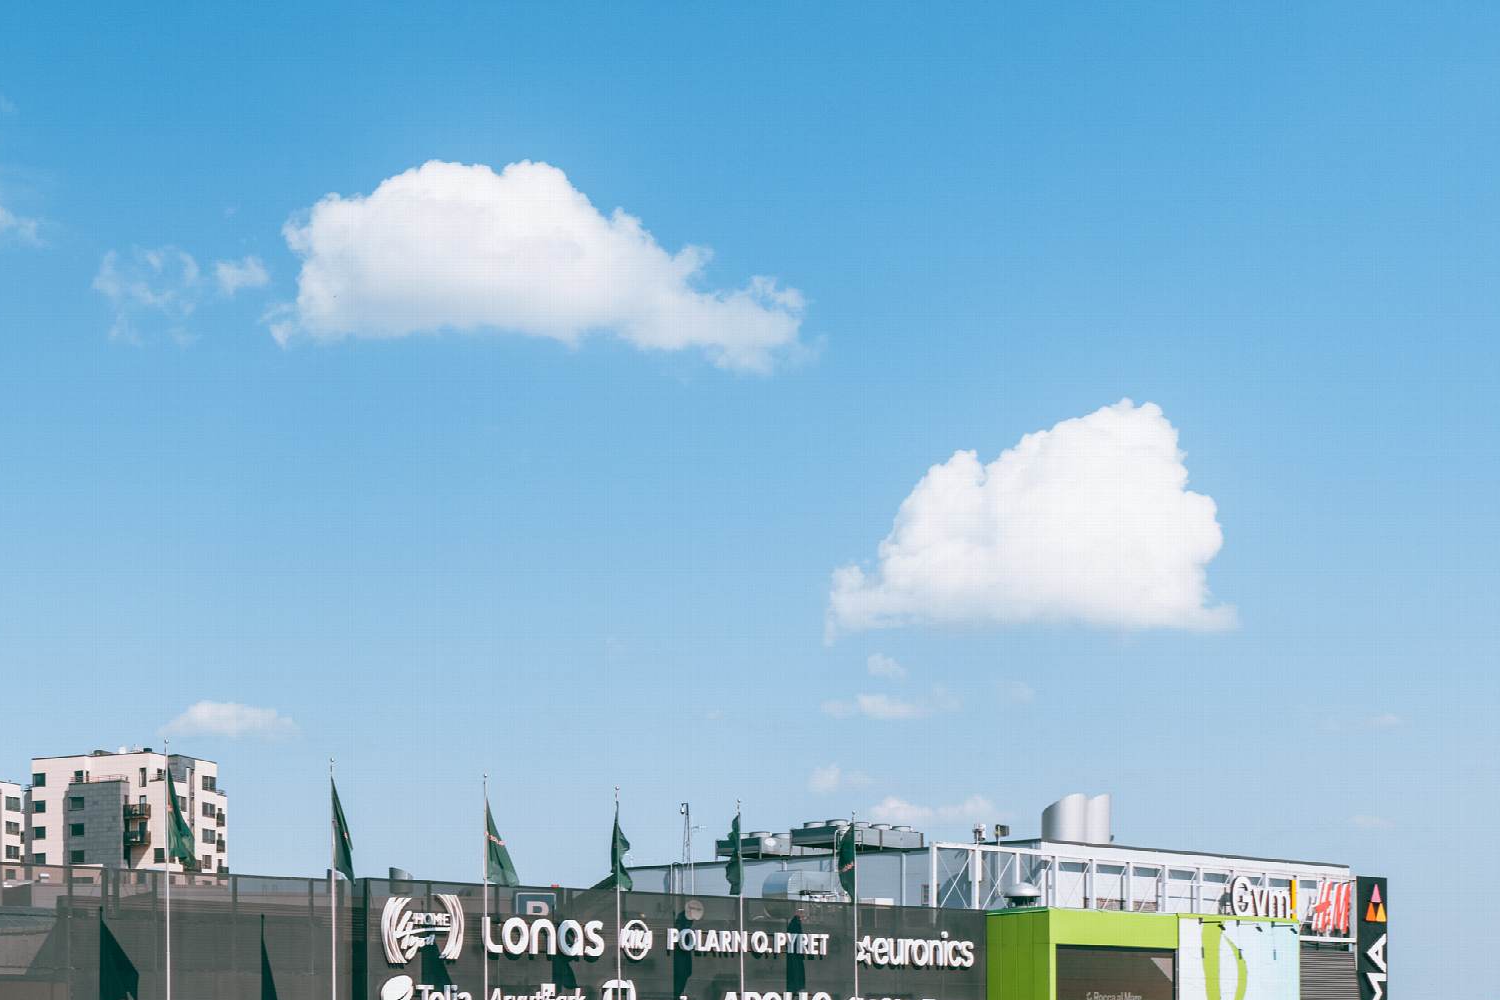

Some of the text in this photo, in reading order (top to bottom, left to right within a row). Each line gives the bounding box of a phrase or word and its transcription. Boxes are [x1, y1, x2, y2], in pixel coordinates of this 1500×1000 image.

[667, 928, 748, 953] POLARN
[773, 932, 830, 956] PYRET
[873, 930, 975, 968] euronics
